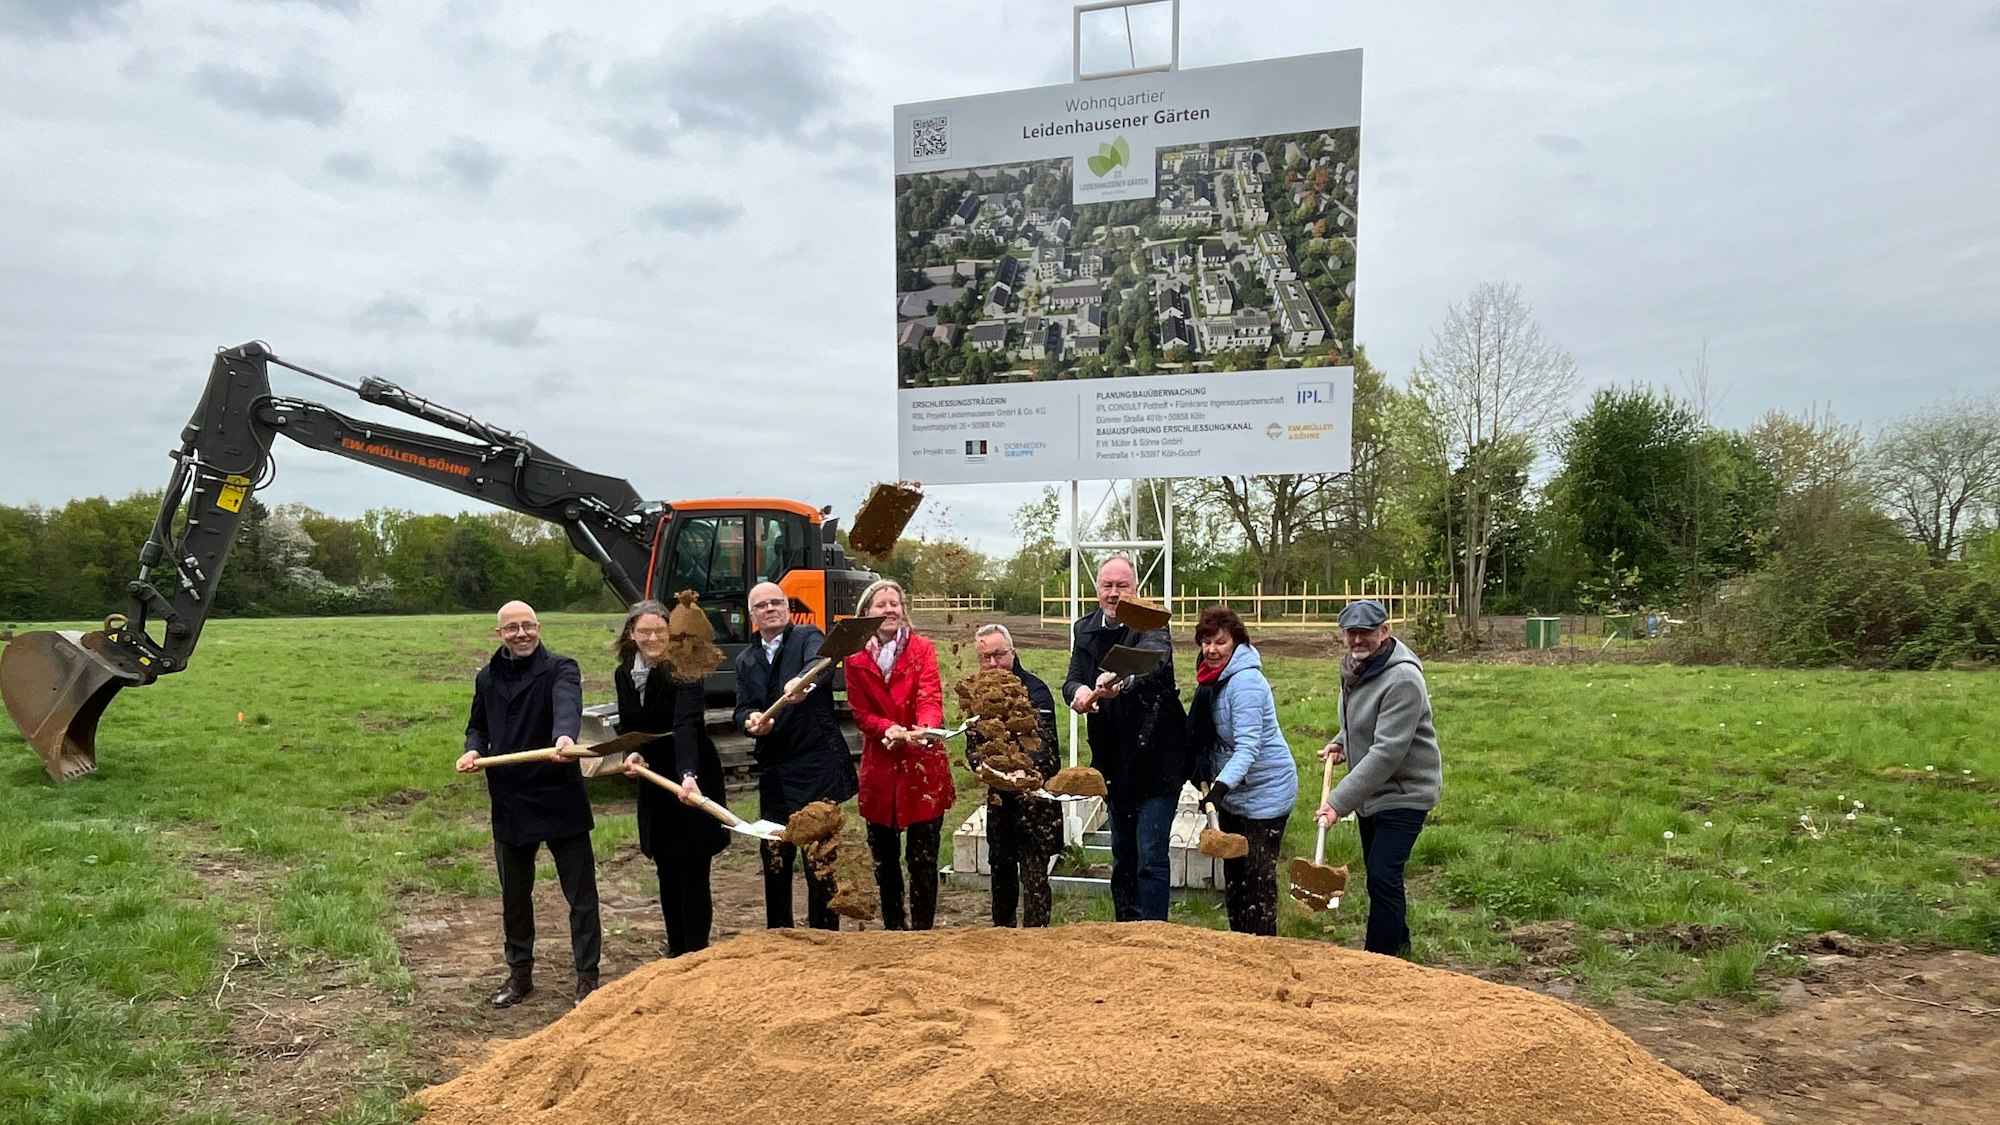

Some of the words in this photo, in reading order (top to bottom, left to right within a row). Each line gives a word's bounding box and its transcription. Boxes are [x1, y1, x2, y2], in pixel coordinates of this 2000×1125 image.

[1065, 90, 1165, 112] Wohnquartier
[1023, 115, 1148, 139] Leidenhausener
[1154, 108, 1210, 125] Gärten
[1096, 388, 1206, 400] PLANUNG/BAUÜBERWACHUNG
[1297, 390, 1322, 404] IPL
[996, 408, 1016, 416] GmbH
[1017, 408, 1022, 416] &
[1035, 407, 1047, 415] KG
[1096, 404, 1107, 412] IPL
[1108, 402, 1142, 411] CONSULT
[1123, 415, 1145, 423] Straße
[1190, 412, 1206, 420] Köln
[991, 420, 1006, 428] Köln
[1096, 426, 1161, 436] BAUAUSFÜHRUNG
[1163, 422, 1253, 433] ERSCHLIESSUNG/KANAL
[1139, 438, 1160, 446] Söhne
[1161, 437, 1183, 446] GmbH
[1004, 449, 1034, 457] GRUPPE
